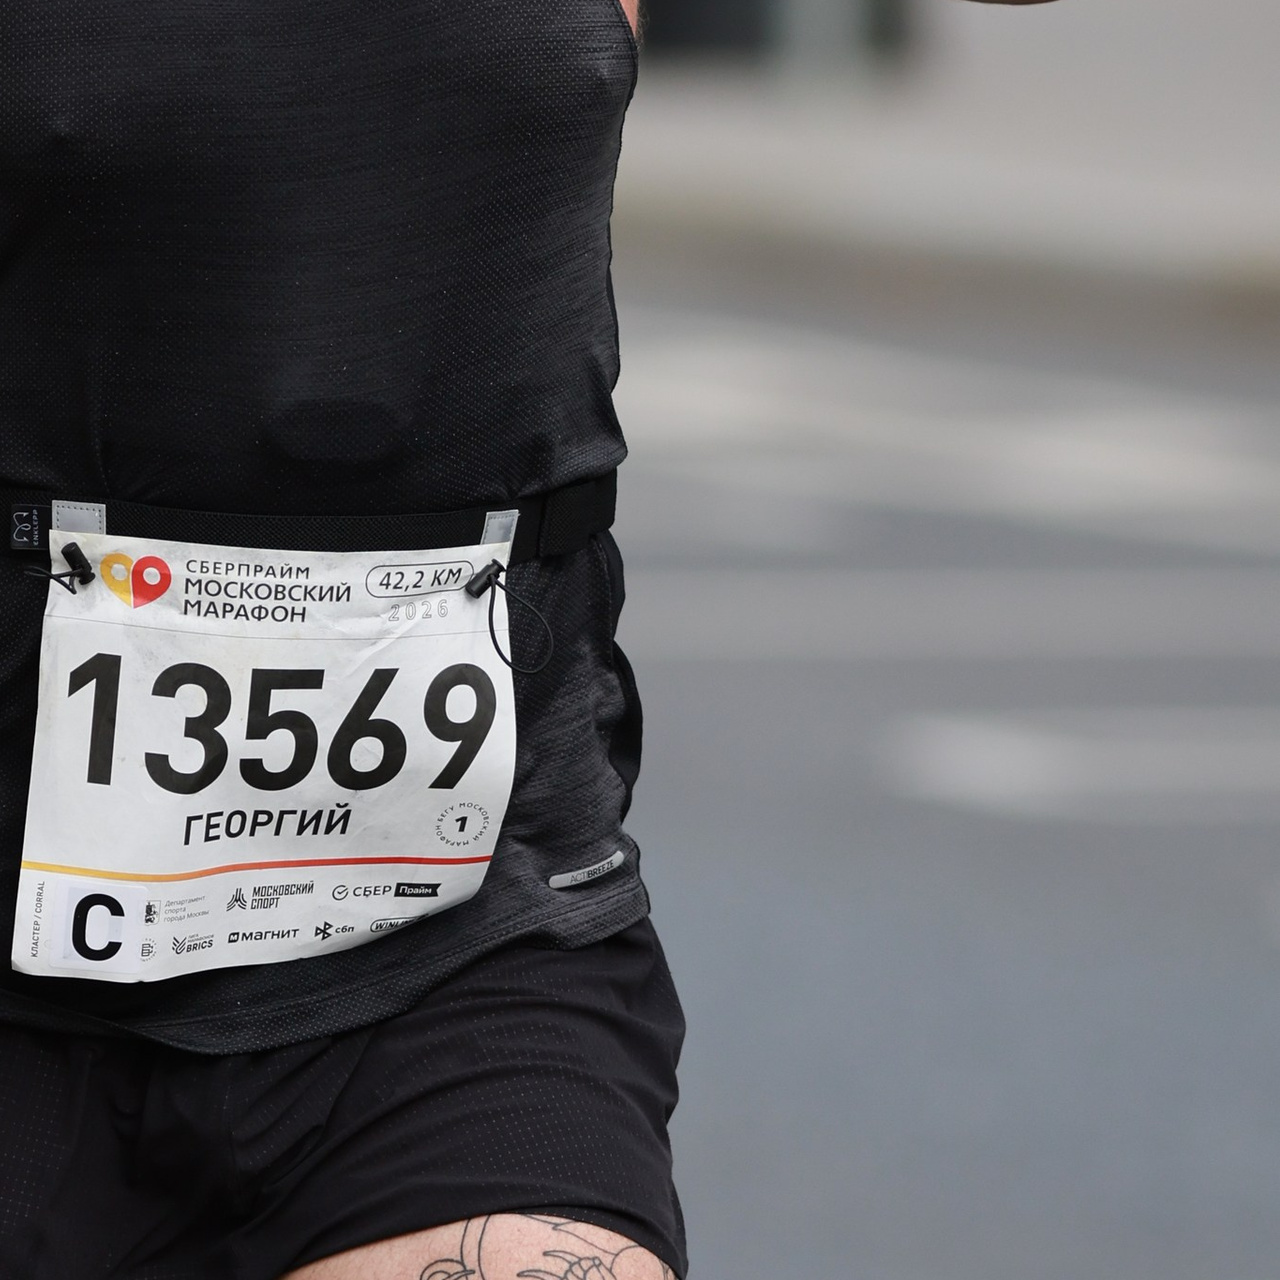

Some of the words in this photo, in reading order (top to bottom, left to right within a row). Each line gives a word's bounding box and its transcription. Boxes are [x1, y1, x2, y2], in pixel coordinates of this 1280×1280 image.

[186, 560, 310, 580] СБЕРПРАЙМ
[184, 578, 352, 602] МОСКОВСКИЙ
[379, 571, 425, 593] 42,2
[183, 599, 307, 623] МАРАФОН
[388, 599, 449, 622] 2026
[67, 652, 498, 796] 13569
[183, 802, 352, 846] ГЕОРГИЙ
[455, 816, 468, 833] 1
[252, 880, 315, 898] МОСКОВСКИЙ
[353, 885, 393, 898] СБЕР
[399, 886, 433, 895] Прайм
[250, 897, 281, 910] СПОРТ
[30, 920, 41, 958] КЛАСТЕР
[186, 939, 214, 953] BRICS
